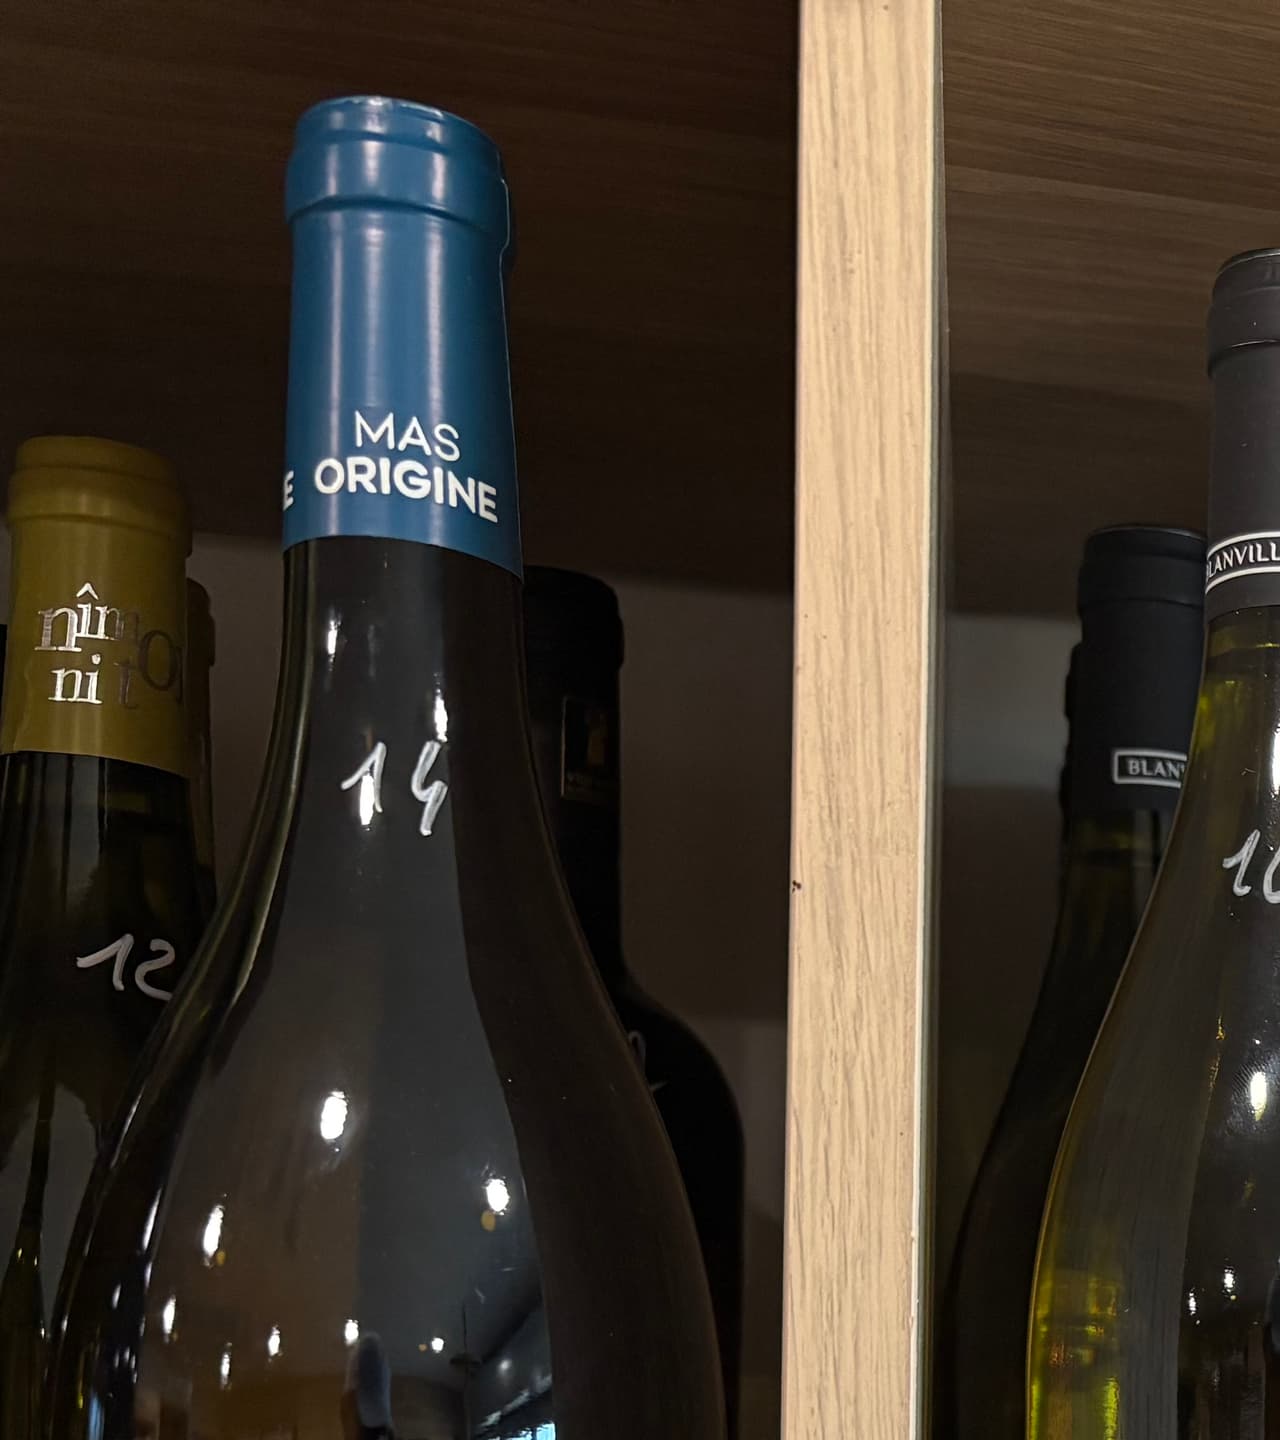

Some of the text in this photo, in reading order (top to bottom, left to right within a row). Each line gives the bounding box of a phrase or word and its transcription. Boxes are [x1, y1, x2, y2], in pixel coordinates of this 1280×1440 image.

[355, 411, 460, 462] MAS
[314, 460, 499, 523] ORIGINE
[76, 933, 175, 1000] 12
